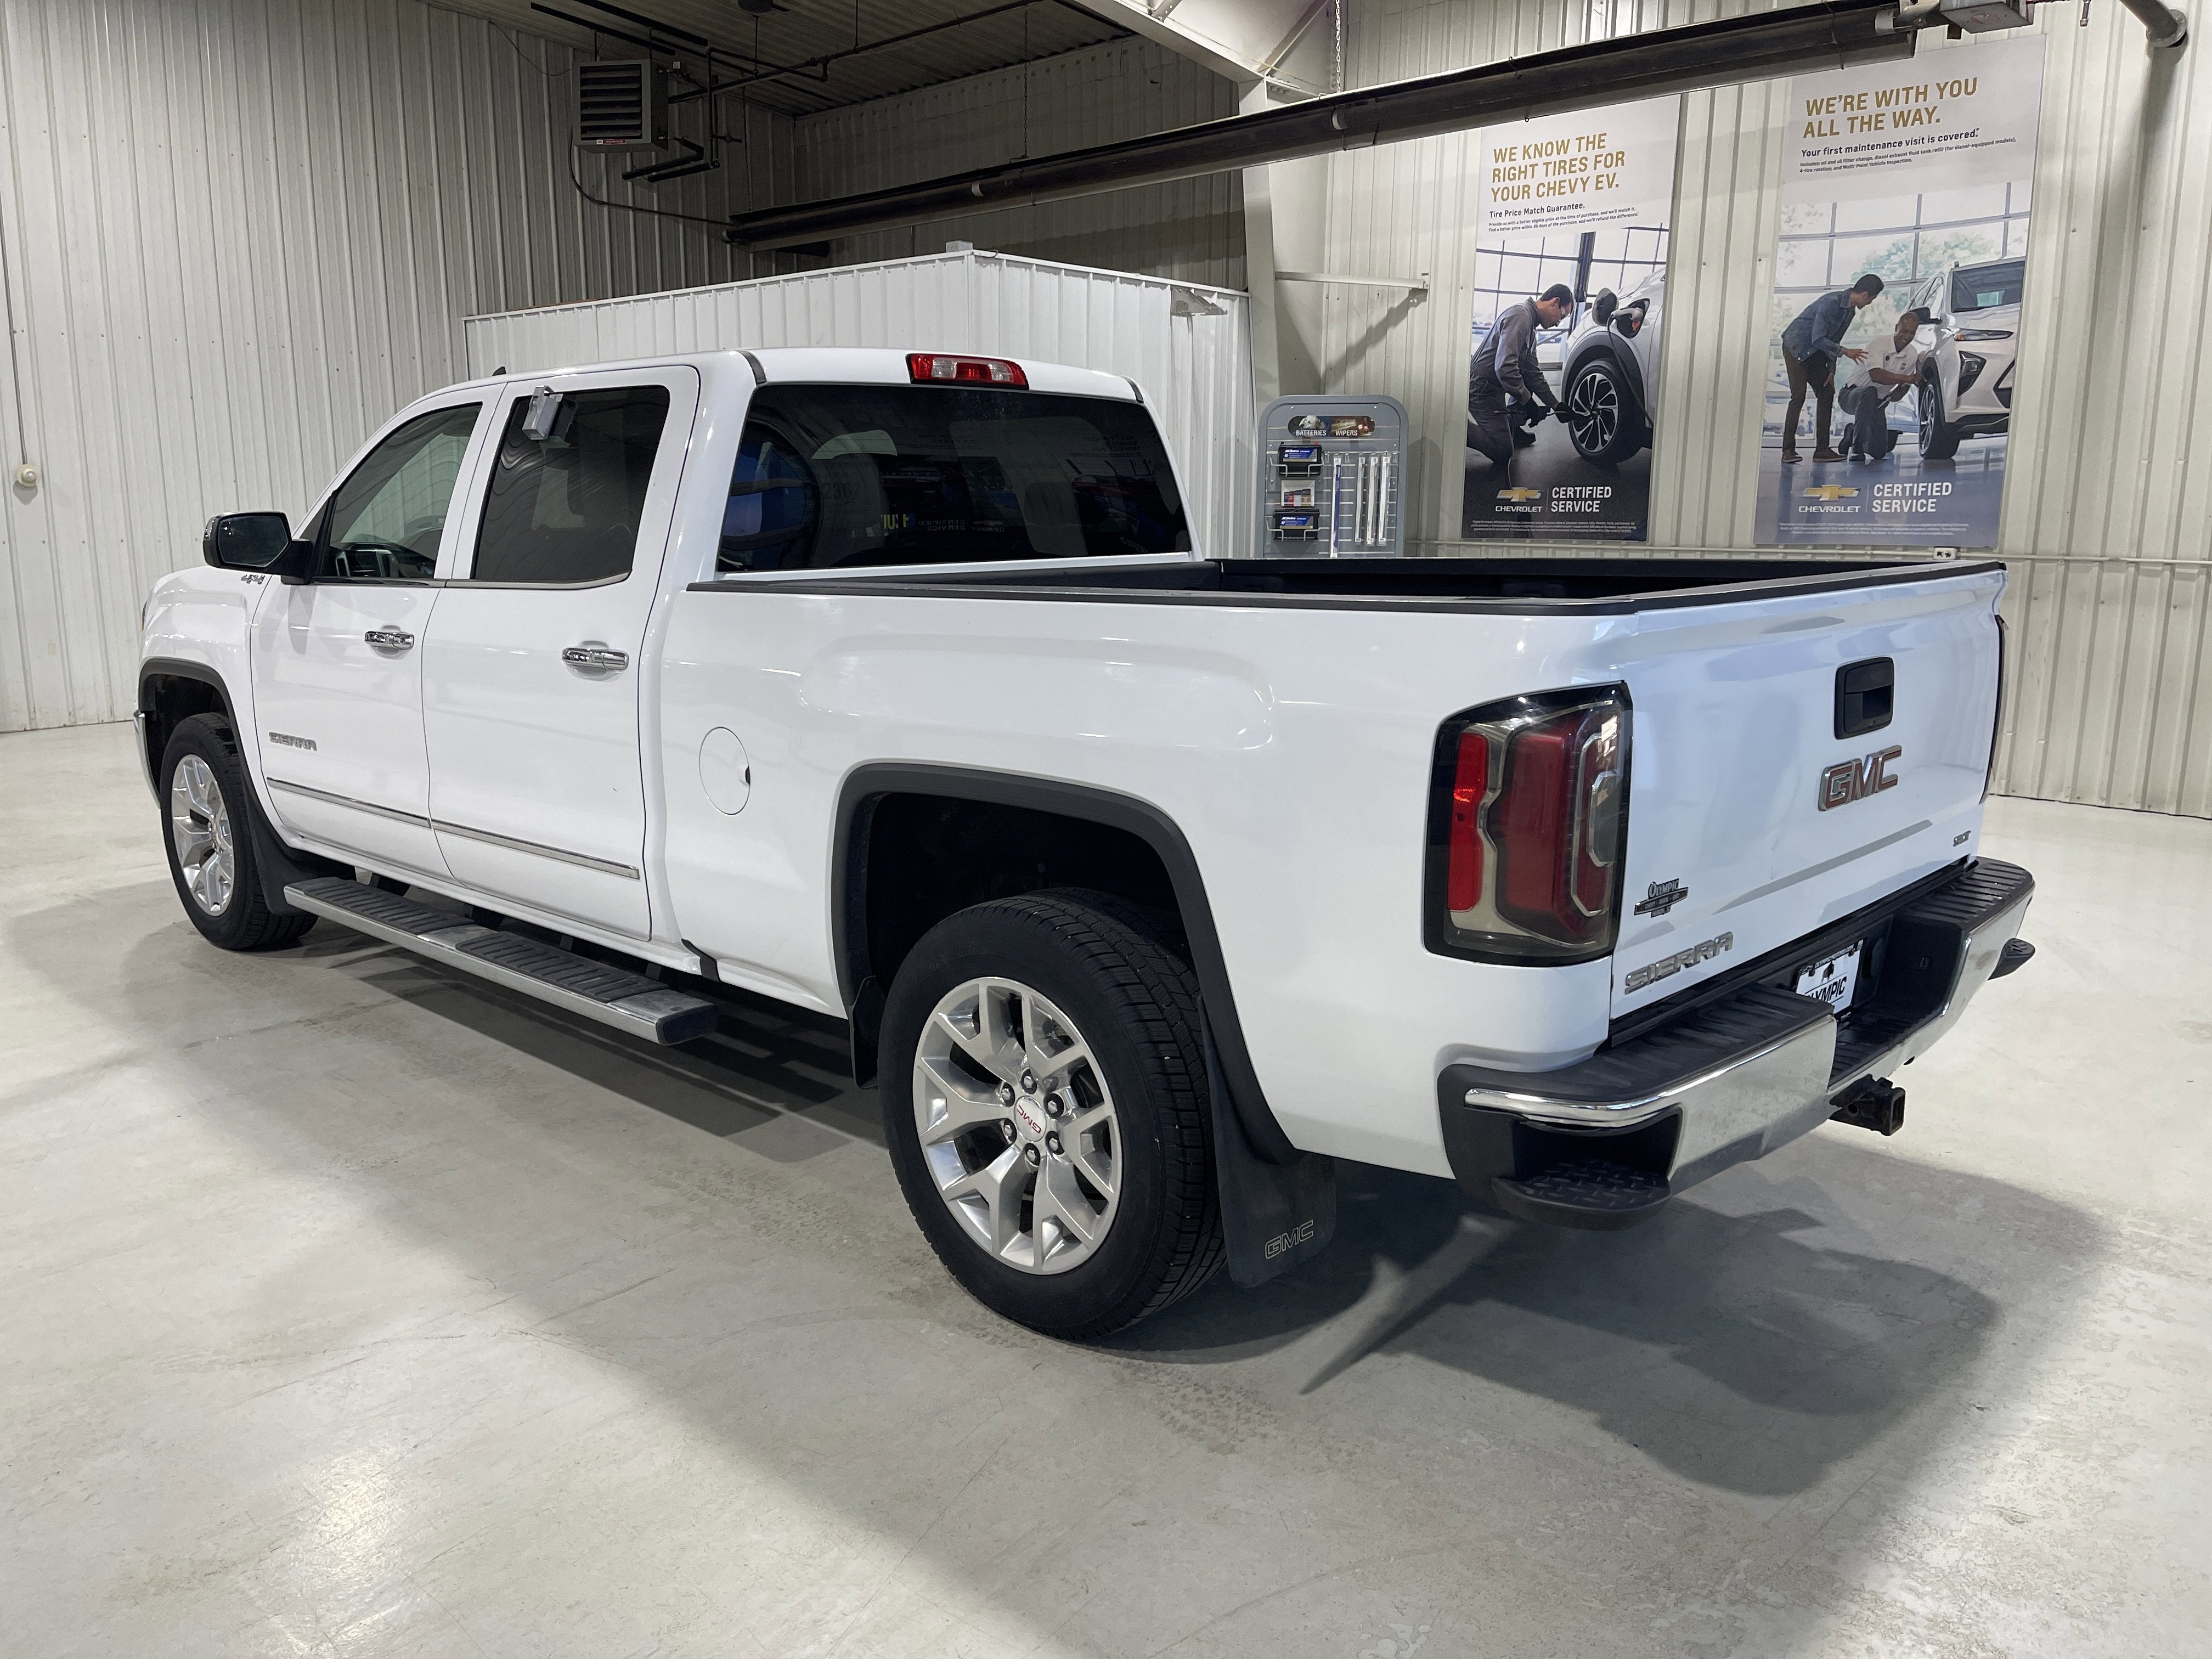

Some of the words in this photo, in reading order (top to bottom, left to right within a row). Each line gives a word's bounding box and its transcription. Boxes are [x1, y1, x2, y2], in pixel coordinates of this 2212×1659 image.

[1806, 92, 1869, 116] WE'RE
[1875, 84, 1928, 108] WITH
[1936, 77, 1977, 100] YOU
[1803, 119, 1840, 139] ALL
[1847, 113, 1886, 134] THE
[1892, 106, 1940, 128] WAY.
[1493, 146, 1517, 163] WE
[1522, 138, 1570, 160] KNOW
[1576, 133, 1607, 152] THE
[1823, 146, 1843, 155] first
[1845, 140, 1903, 154] maintenance
[1905, 137, 1925, 146] visit
[1927, 135, 1935, 143] is
[1492, 163, 1538, 183] RIGHT
[1543, 156, 1588, 177] TIRES
[1594, 151, 1625, 170] FOR
[1491, 184, 1531, 202] YOUR
[1536, 176, 1590, 198] CHEVY
[1595, 172, 1619, 190] EV.
[1524, 206, 1544, 215] Match
[1551, 487, 1612, 499] CERTIFIED
[1874, 482, 1952, 497] CERTIFIED
[1551, 500, 1600, 512] SERVICE
[1871, 499, 1937, 513] SERVICE
[269, 731, 317, 752] SIERRA
[1818, 744, 1903, 812] GMC
[1624, 931, 1734, 995] SIERRA
[1017, 1104, 1041, 1133] GMC
[1265, 1219, 1313, 1259] GMC
